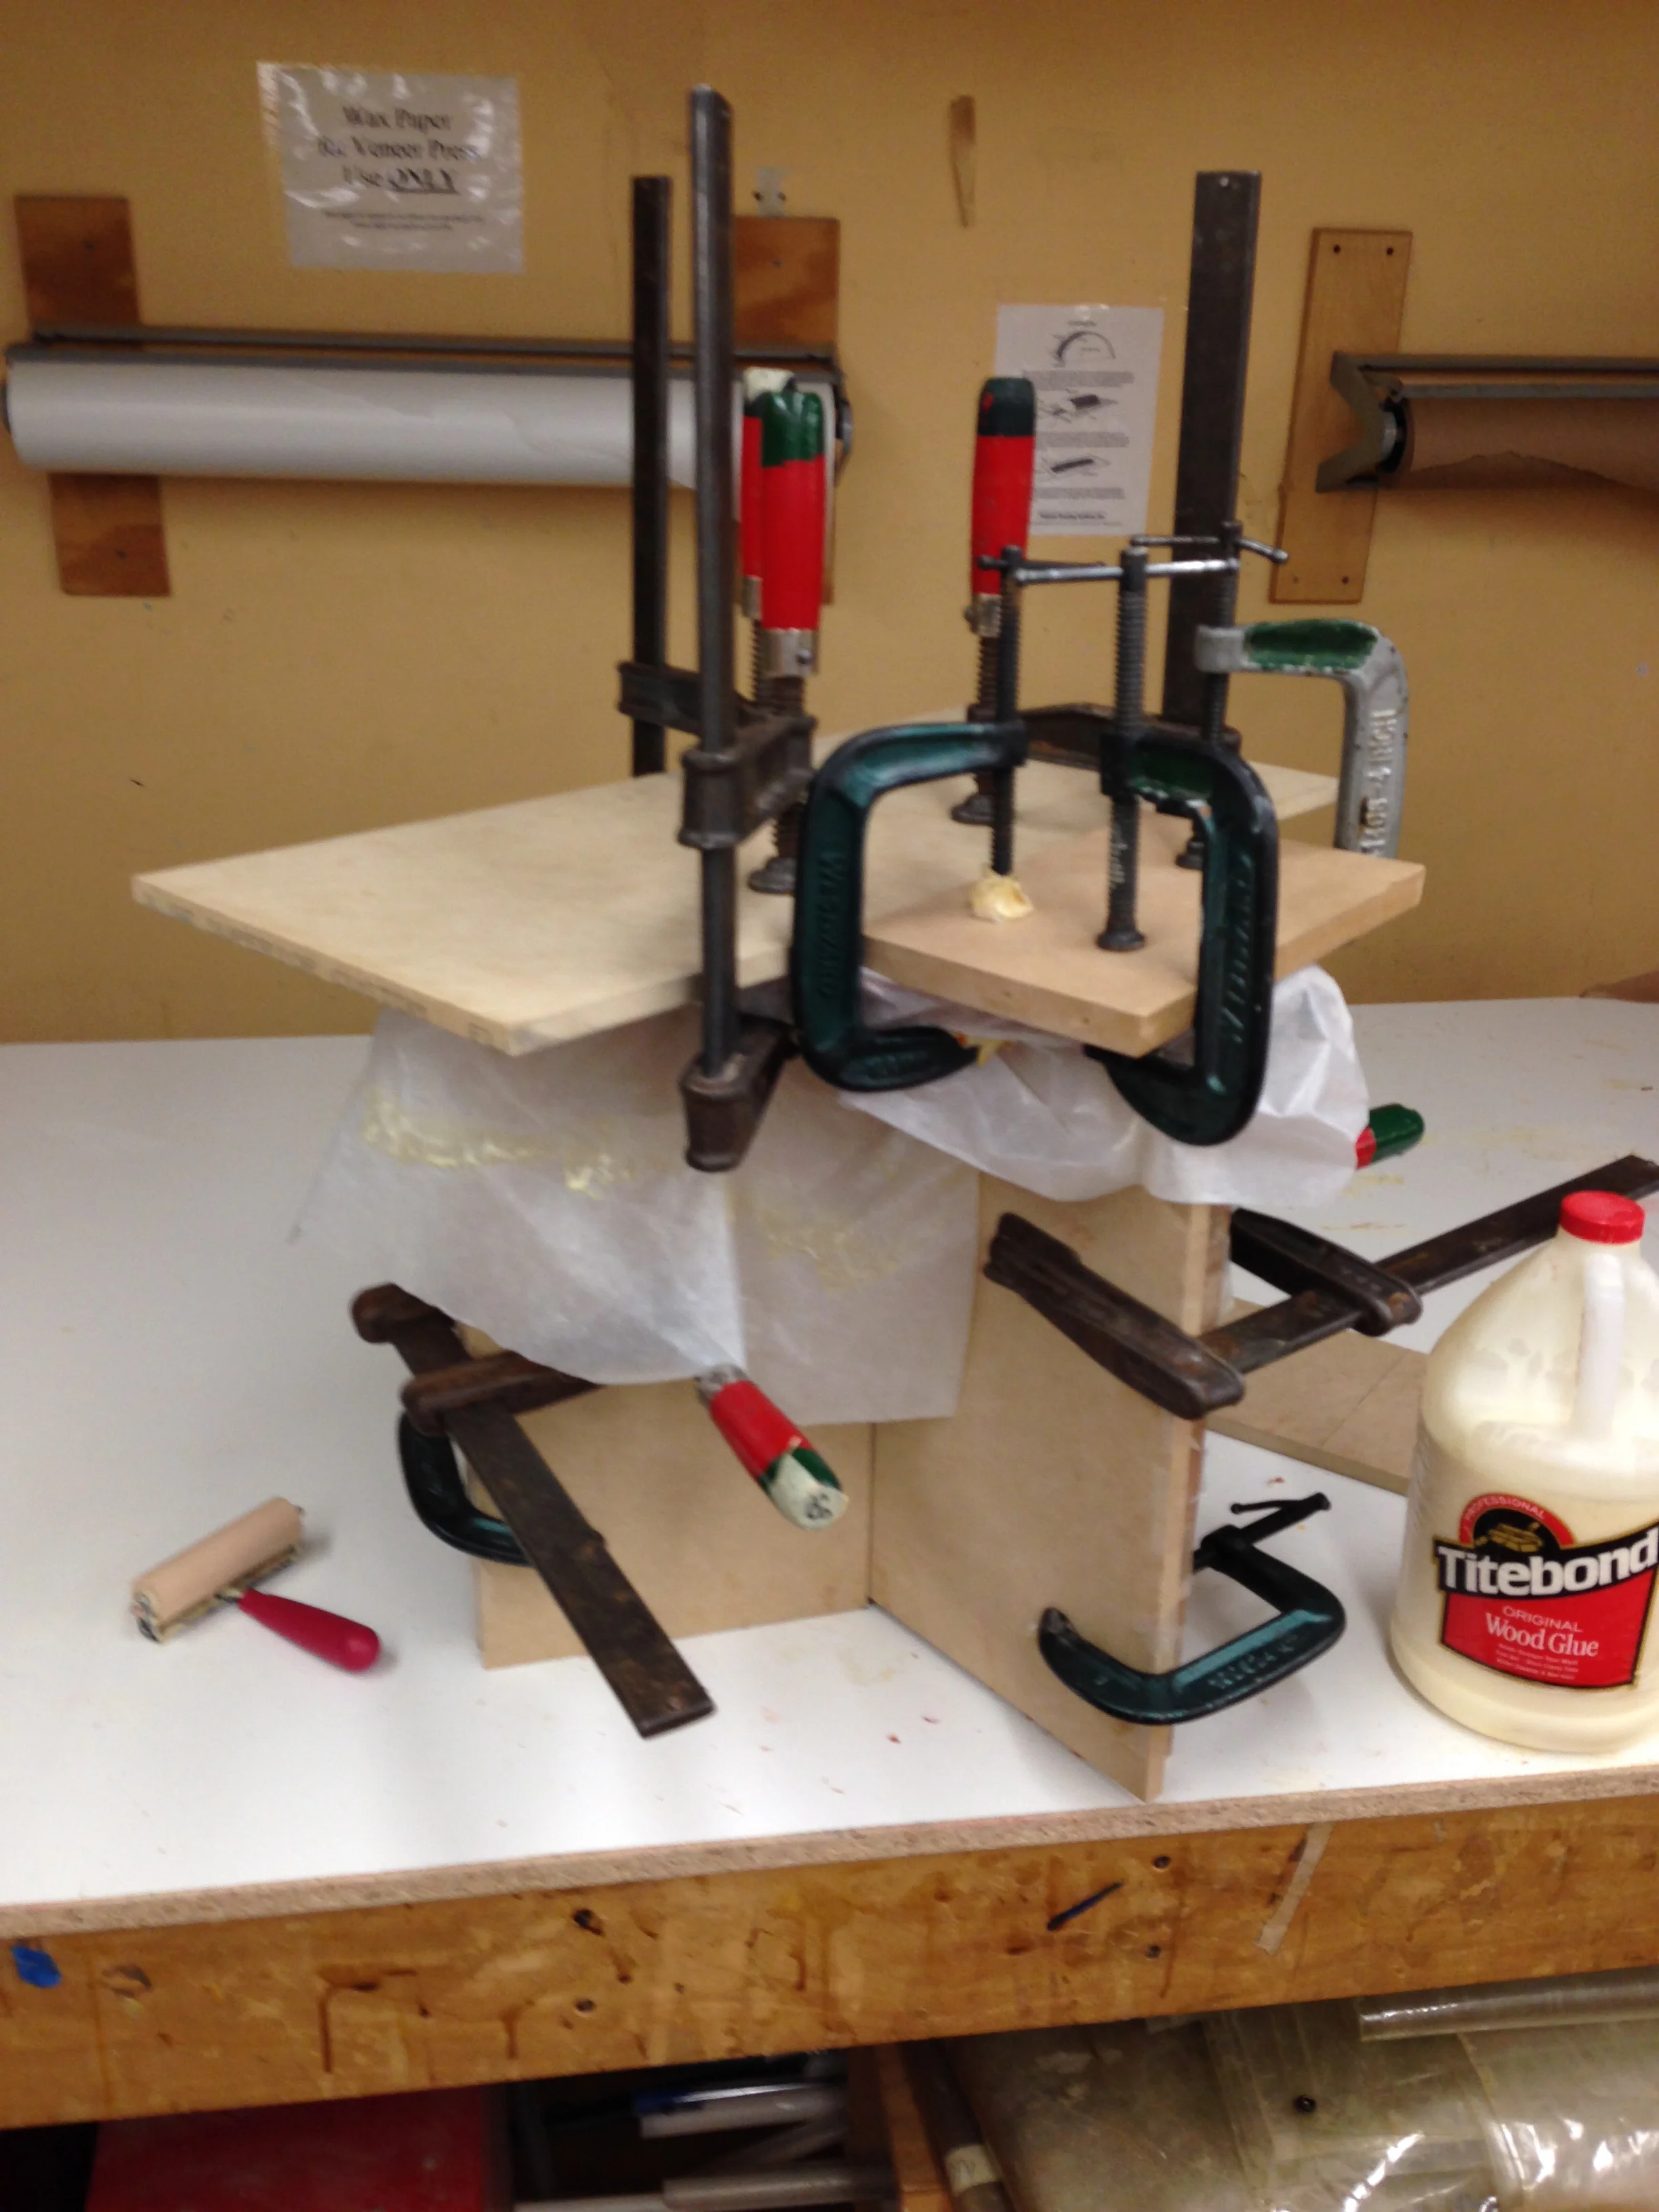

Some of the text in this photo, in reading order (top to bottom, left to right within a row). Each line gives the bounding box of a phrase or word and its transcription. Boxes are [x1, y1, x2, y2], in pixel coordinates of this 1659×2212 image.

[1465, 1495, 1545, 1521] PROFESSIONAL
[1437, 1526, 1658, 1596] Titebond
[1486, 1612, 1545, 1651] Wood
[1548, 1631, 1600, 1658] Glue
[1502, 1605, 1584, 1633] ORIGINAL
